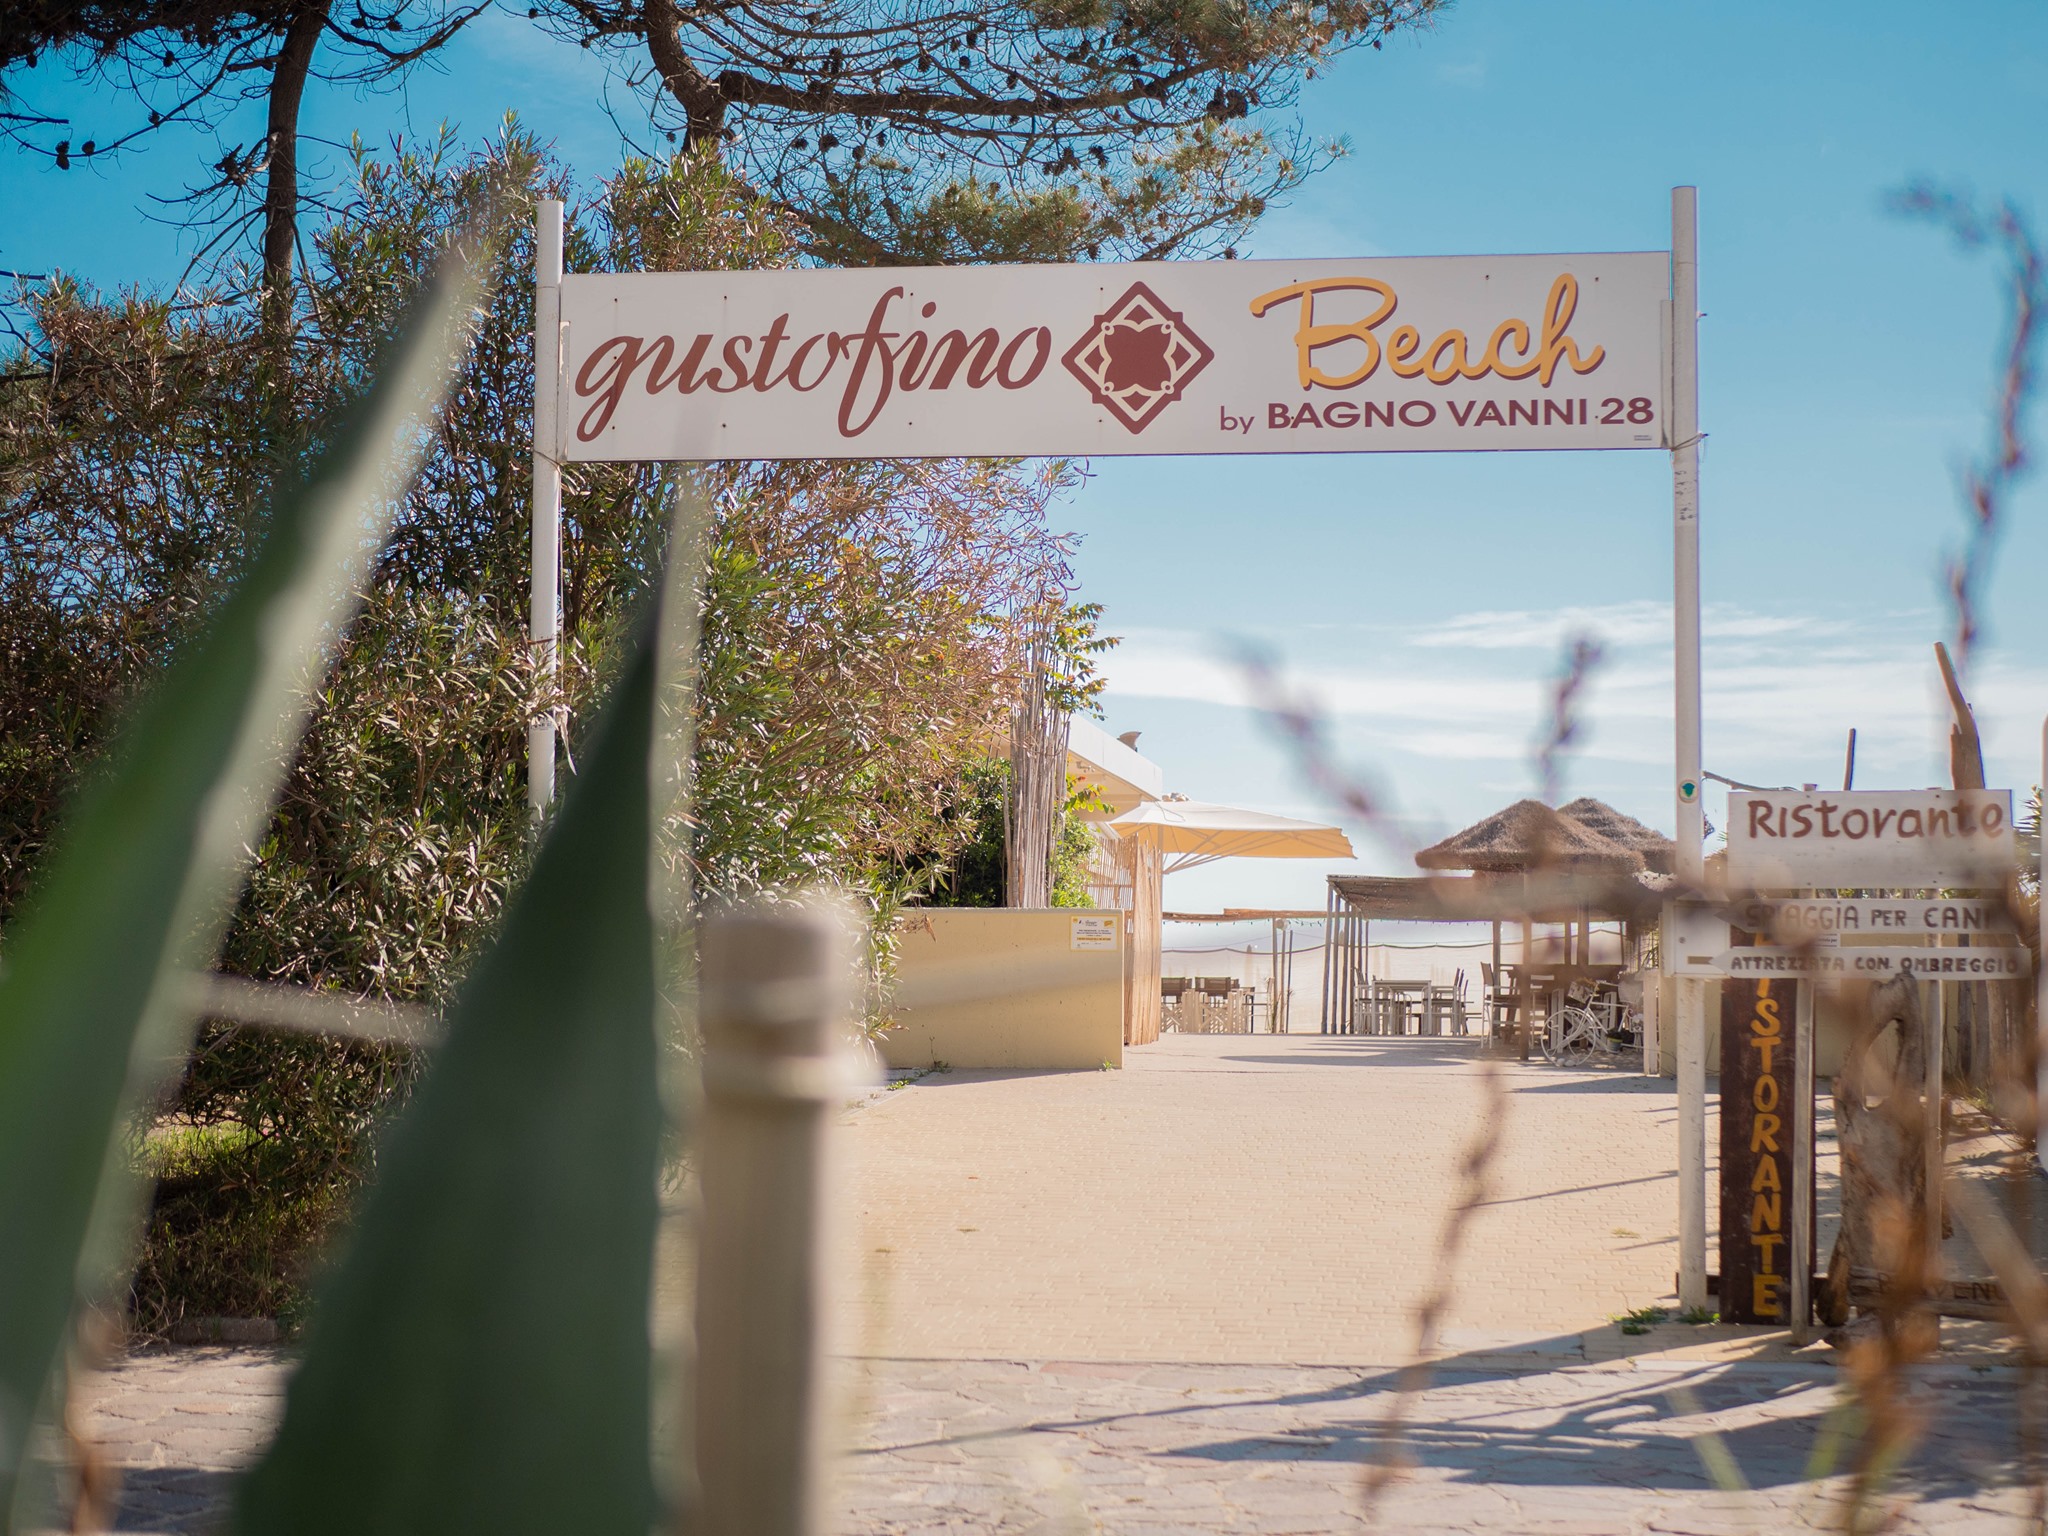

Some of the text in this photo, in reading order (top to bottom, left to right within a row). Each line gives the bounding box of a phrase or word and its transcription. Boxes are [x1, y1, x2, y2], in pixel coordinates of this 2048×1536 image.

[1249, 273, 1605, 390] Beach
[575, 286, 1052, 442] gustofino
[1220, 397, 1654, 434] by BAGNO VANNI 28
[1871, 909, 1907, 927] PER
[1855, 956, 1890, 971] CON
